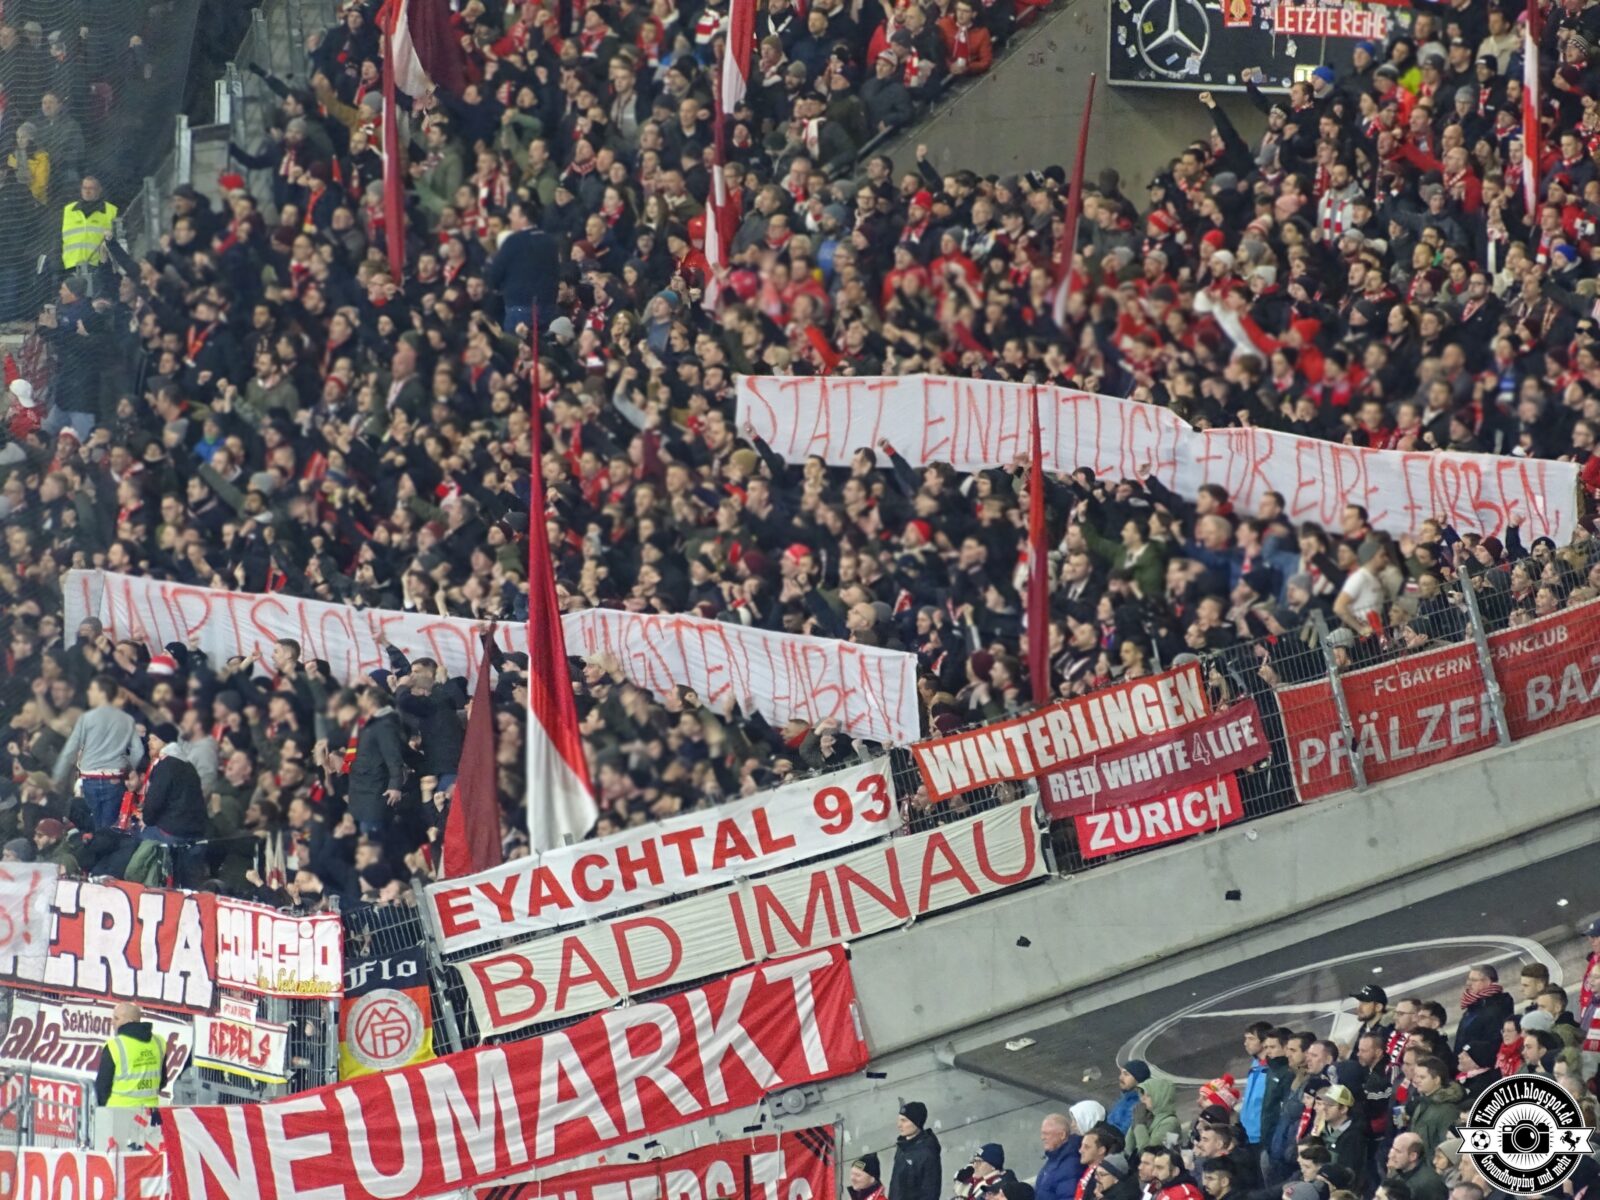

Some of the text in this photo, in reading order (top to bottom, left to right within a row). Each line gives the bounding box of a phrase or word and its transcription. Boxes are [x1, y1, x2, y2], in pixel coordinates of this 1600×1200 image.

[1275, 6, 1338, 34] LETZTE
[745, 375, 898, 459] STATT
[920, 377, 1179, 490] EINHEITLICH
[1196, 429, 1274, 505] FÜR
[1291, 440, 1389, 530] EURE
[762, 636, 907, 741] HABEN!
[1374, 625, 1569, 696] FC BAYERN ANCLUB
[920, 667, 1208, 796] WINTERLINGEN
[1048, 715, 1260, 802] RED WHITE 4 LIFE
[433, 773, 892, 938] EYACHTAL 93
[1086, 781, 1233, 851] ZÜRICH
[0, 880, 214, 1010] ERIA
[469, 916, 682, 1030] BAD
[728, 805, 1037, 961] IMNAU
[173, 951, 834, 1200] NEUMARKT
[209, 1022, 271, 1068] REBELS
